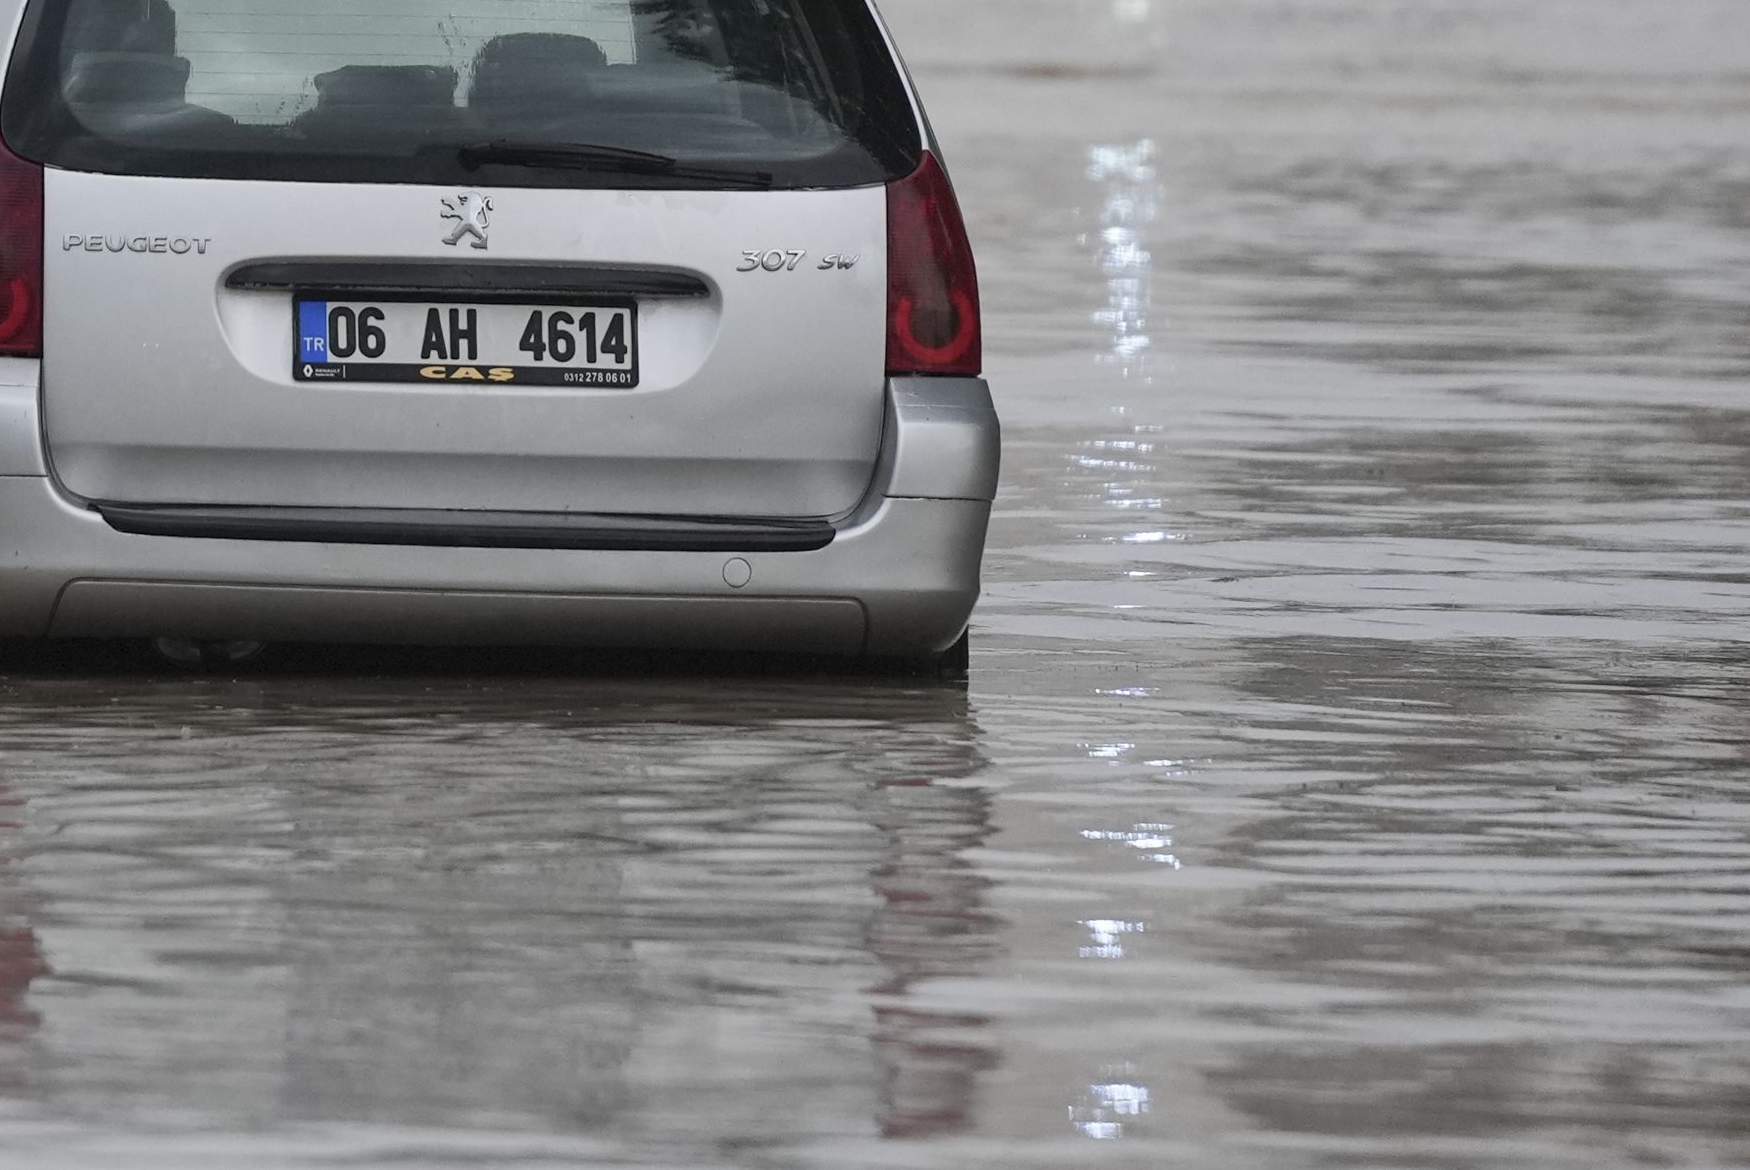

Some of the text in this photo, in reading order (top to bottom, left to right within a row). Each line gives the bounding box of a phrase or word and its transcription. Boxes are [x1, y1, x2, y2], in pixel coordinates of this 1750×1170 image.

[62, 232, 211, 255] PEUGEOT
[736, 248, 807, 272] 307
[303, 337, 325, 352] TR
[328, 306, 628, 364] 06 AH 4614
[419, 365, 515, 382] CAŞ
[563, 372, 631, 384] 0312 278 06 01
